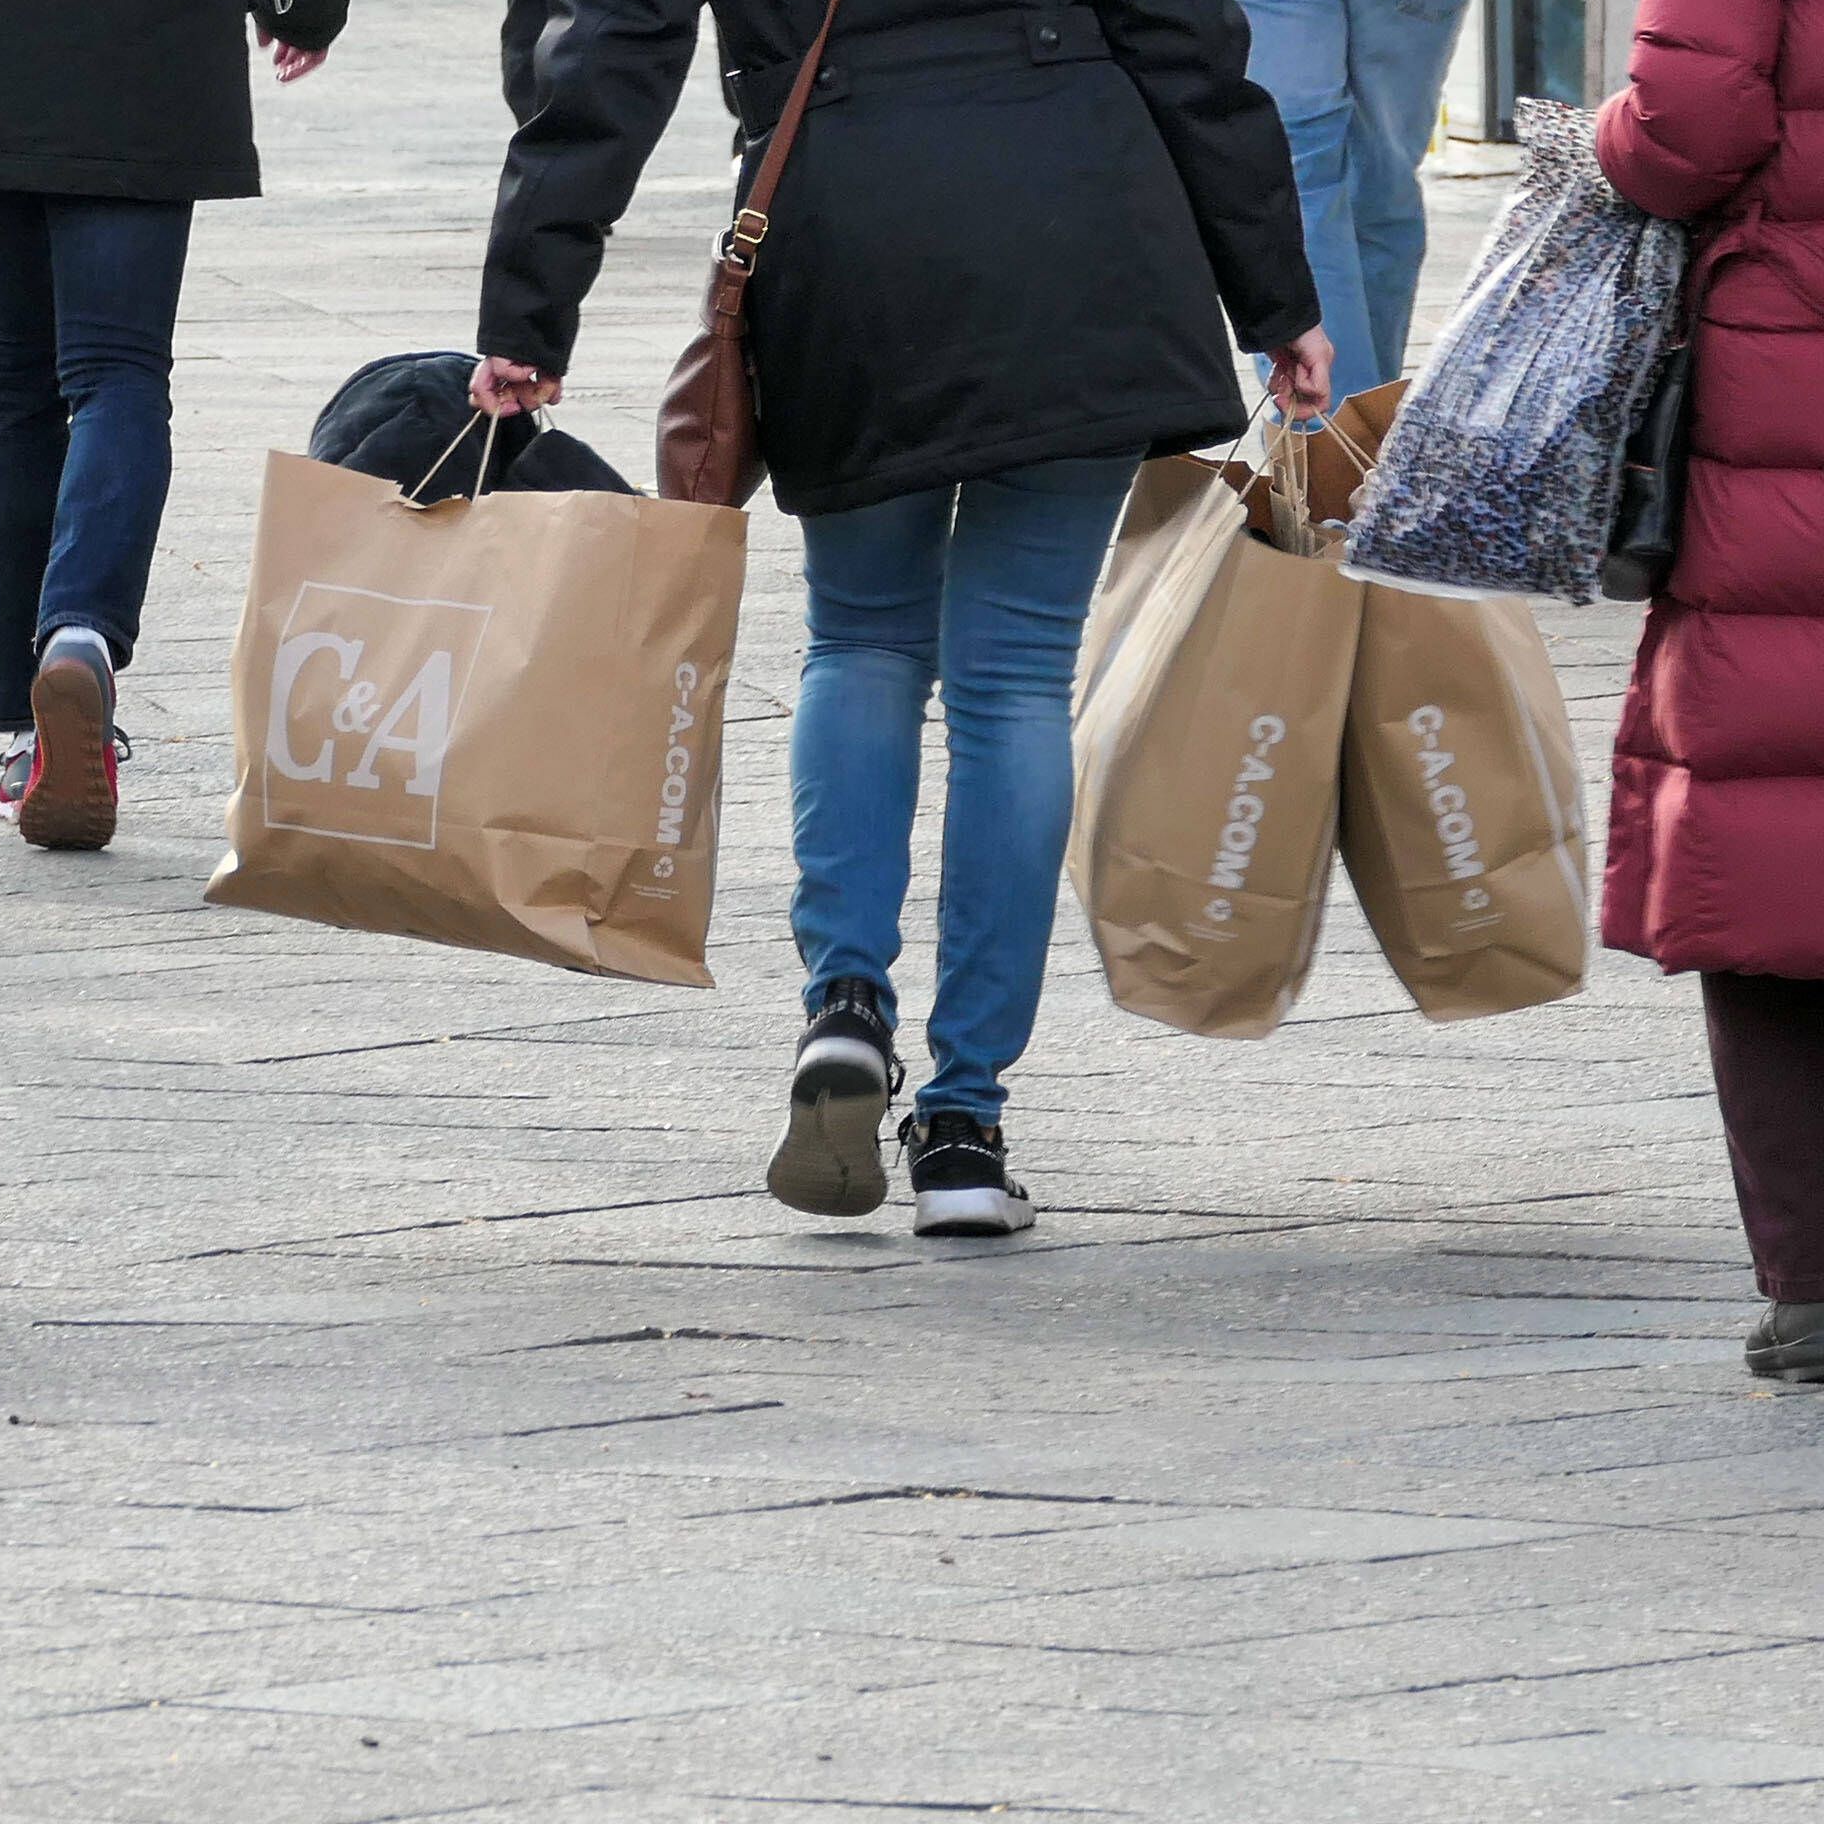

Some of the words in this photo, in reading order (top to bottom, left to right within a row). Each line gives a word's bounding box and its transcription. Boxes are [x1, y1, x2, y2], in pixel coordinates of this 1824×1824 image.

[266, 631, 452, 797] C&A
[654, 661, 702, 846] C-A.COM
[1206, 712, 1286, 890] C-A.COM
[1407, 703, 1483, 881] C-A.COM
